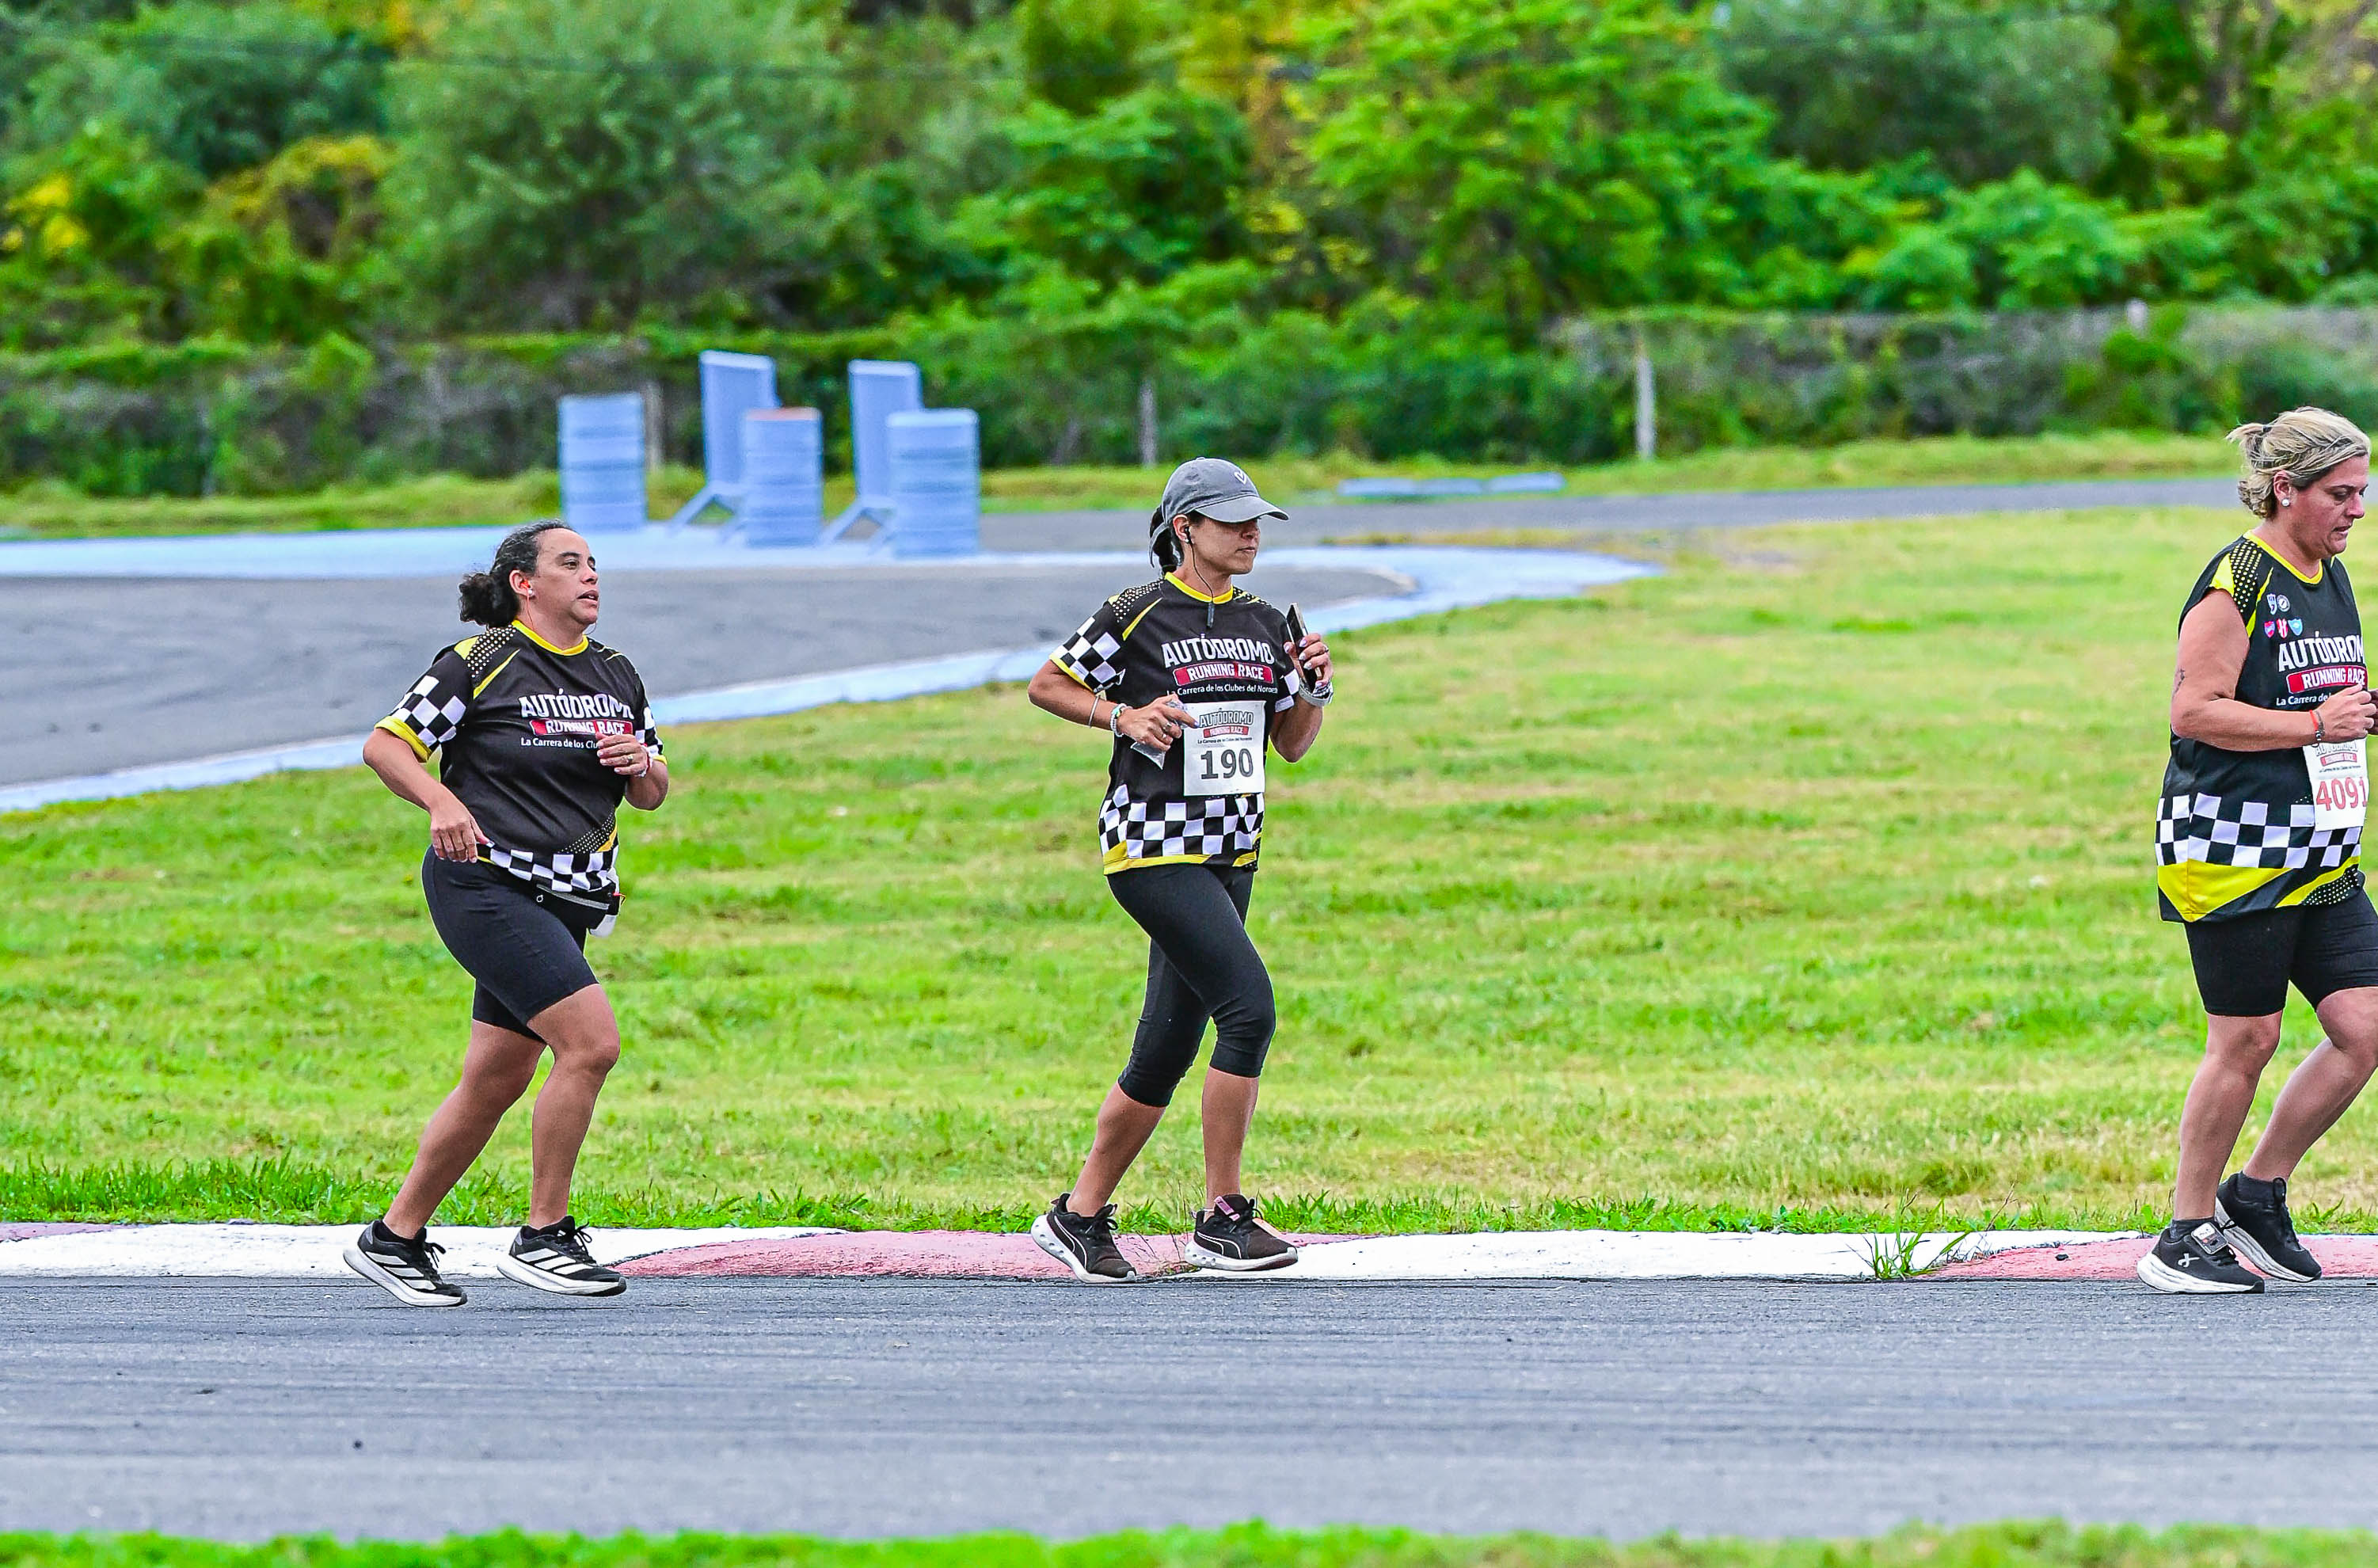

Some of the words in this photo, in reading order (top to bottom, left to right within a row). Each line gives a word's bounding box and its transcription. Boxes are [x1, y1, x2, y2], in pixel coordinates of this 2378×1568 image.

[1161, 633, 1275, 668] AUTÓDROMO
[2278, 630, 2365, 672] AUTÓDROM
[1187, 663, 1235, 681] RUNNING
[1238, 664, 1265, 680] RACE
[2301, 668, 2346, 689] RUNNING
[2347, 668, 2365, 686] RACE
[1177, 687, 1205, 695] Carrera
[2276, 697, 2286, 706] La
[2288, 693, 2317, 705] Carrera
[2318, 692, 2328, 702] de
[545, 719, 595, 734] RUNNING
[595, 721, 626, 735] RACE
[1199, 707, 1254, 728] AUTÓDROMO
[520, 737, 531, 746] La
[532, 737, 563, 748] Carrera
[563, 738, 573, 748] de
[573, 739, 584, 748] los
[1200, 748, 1254, 779] 190
[2315, 776, 2368, 812] 4091
